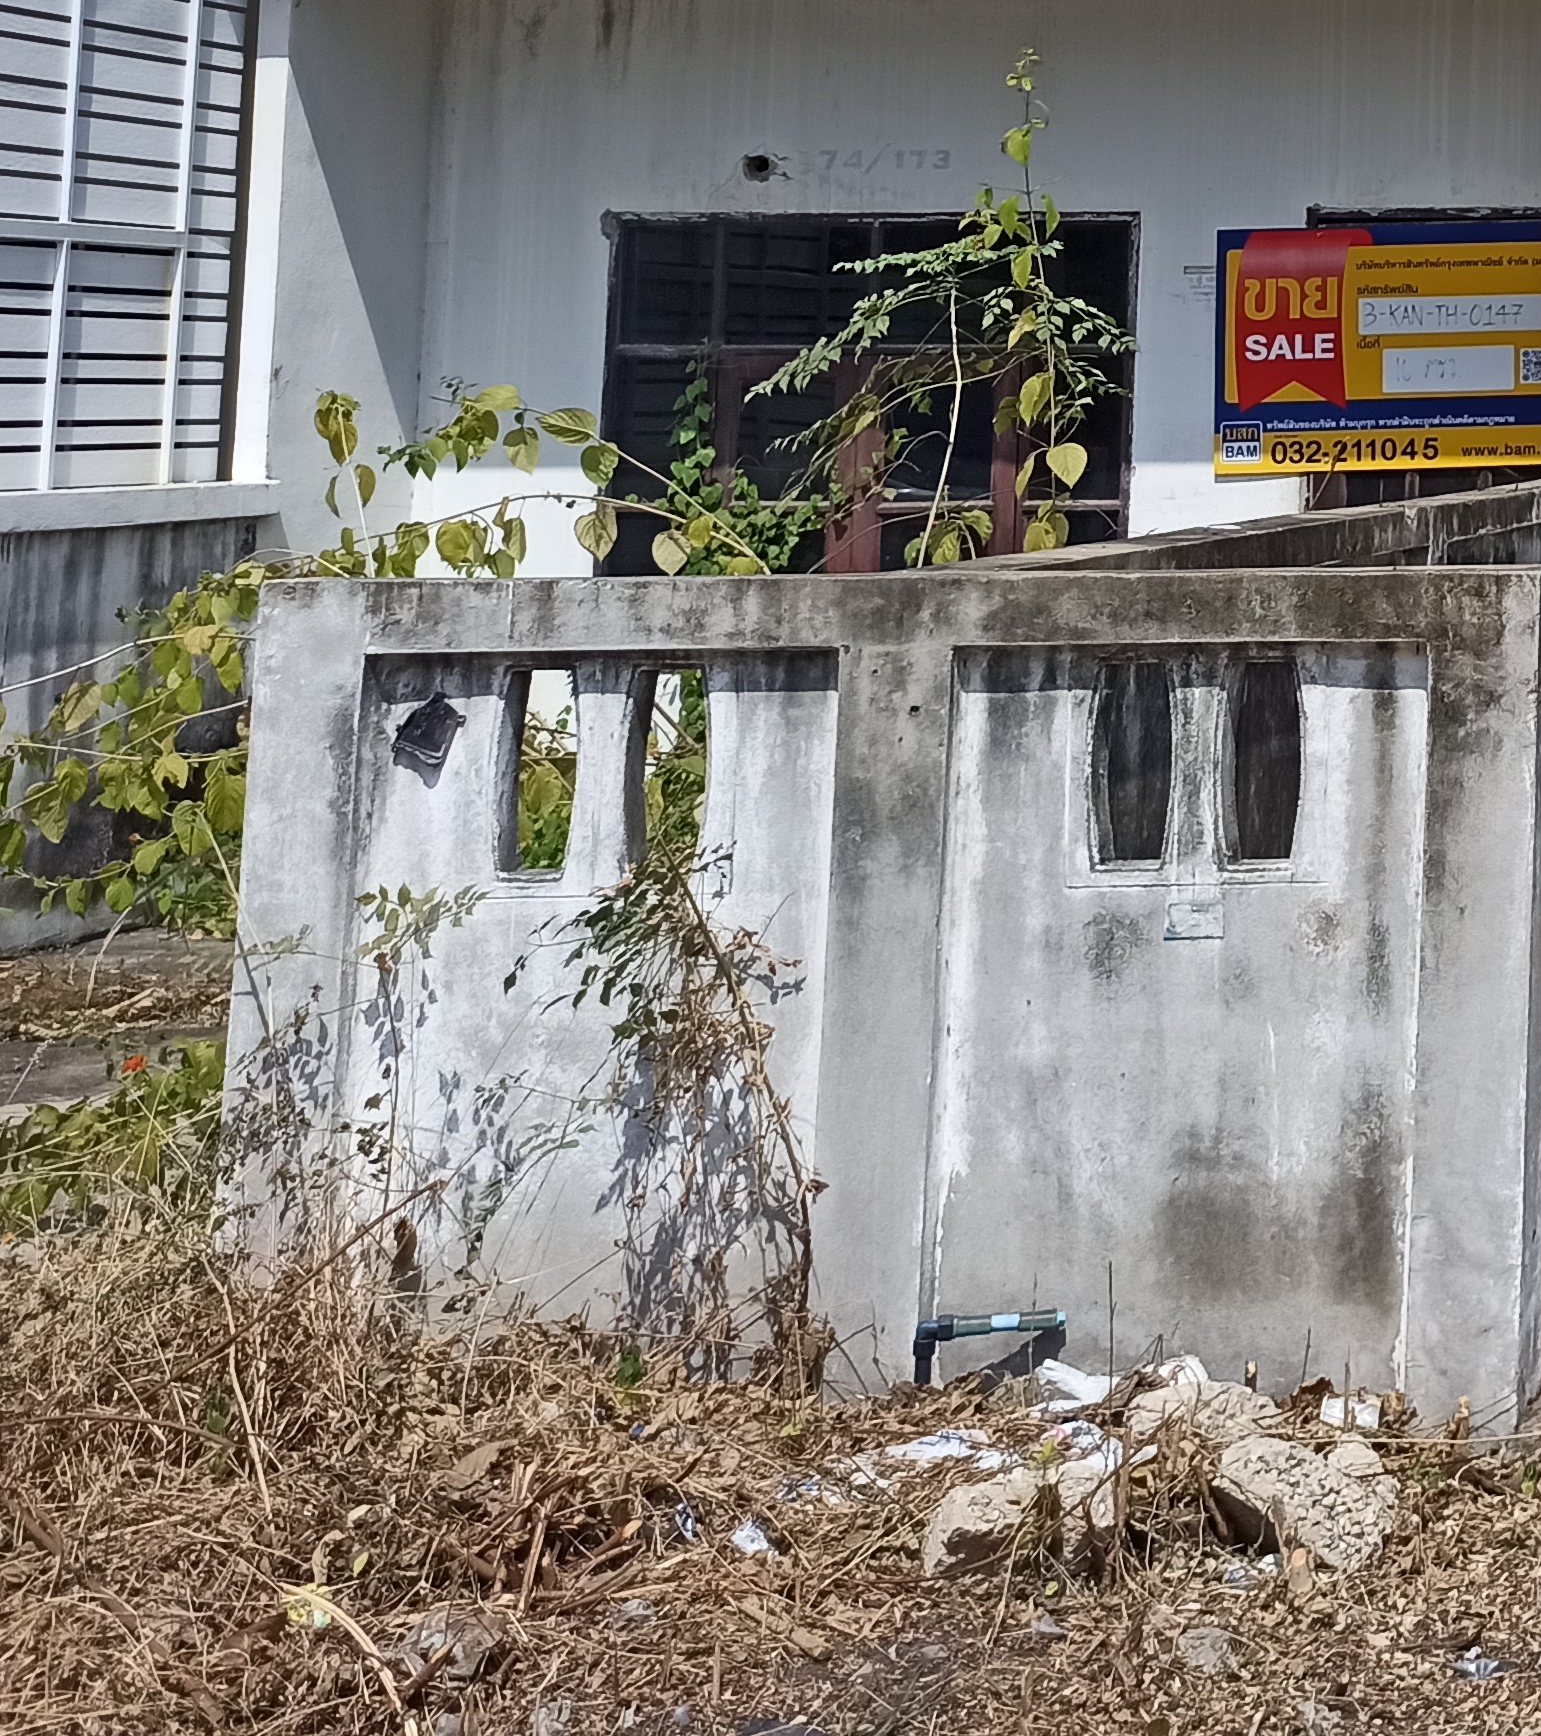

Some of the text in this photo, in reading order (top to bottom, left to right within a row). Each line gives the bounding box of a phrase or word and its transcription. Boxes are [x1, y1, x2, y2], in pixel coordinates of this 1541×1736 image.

[818, 142, 951, 175] 74/173
[1245, 277, 1338, 320] ขาย
[1245, 333, 1335, 361] SALE
[1225, 427, 1258, 440] บสก
[1225, 445, 1258, 458] BAM
[1271, 437, 1439, 464] 032-211045
